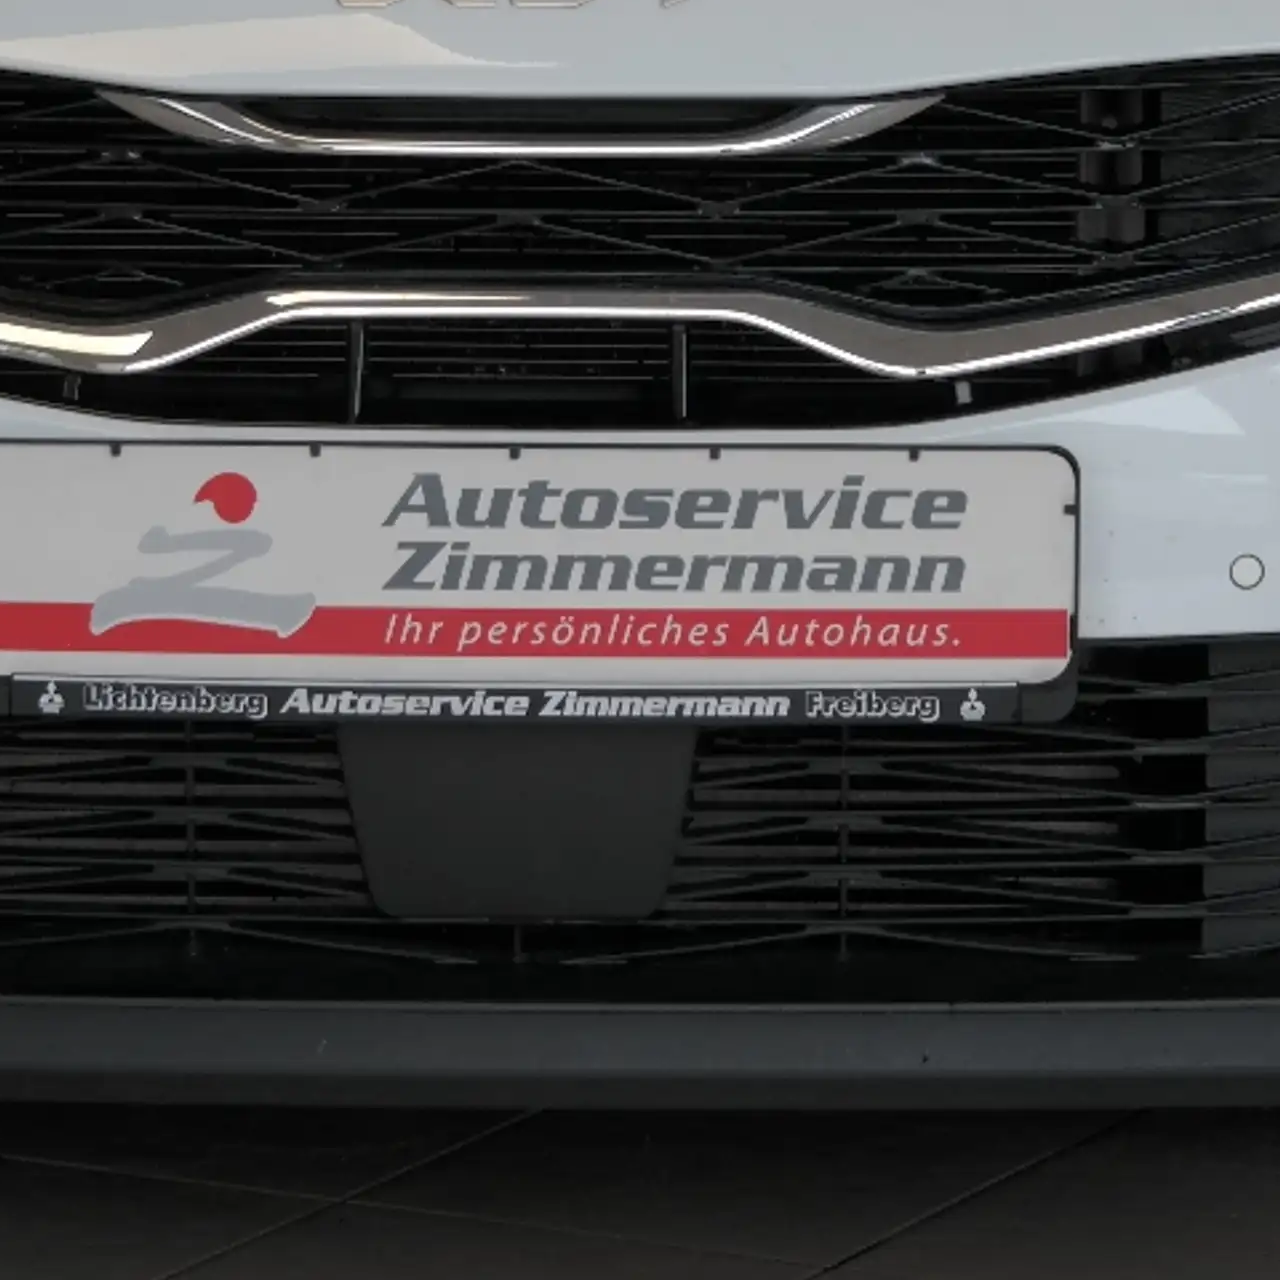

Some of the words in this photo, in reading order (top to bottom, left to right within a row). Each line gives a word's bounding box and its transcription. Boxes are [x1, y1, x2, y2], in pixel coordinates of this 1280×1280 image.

[381, 472, 967, 529] Autoservice
[381, 541, 966, 592] Zimmermann
[384, 614, 443, 644] Ihr
[458, 614, 728, 652] persönliches
[745, 615, 962, 646] Autohaus.
[82, 683, 268, 718] Lichtenberg
[281, 688, 529, 717] Autoservice
[538, 690, 790, 717] Zimmermann
[805, 691, 940, 722] Freiberg
